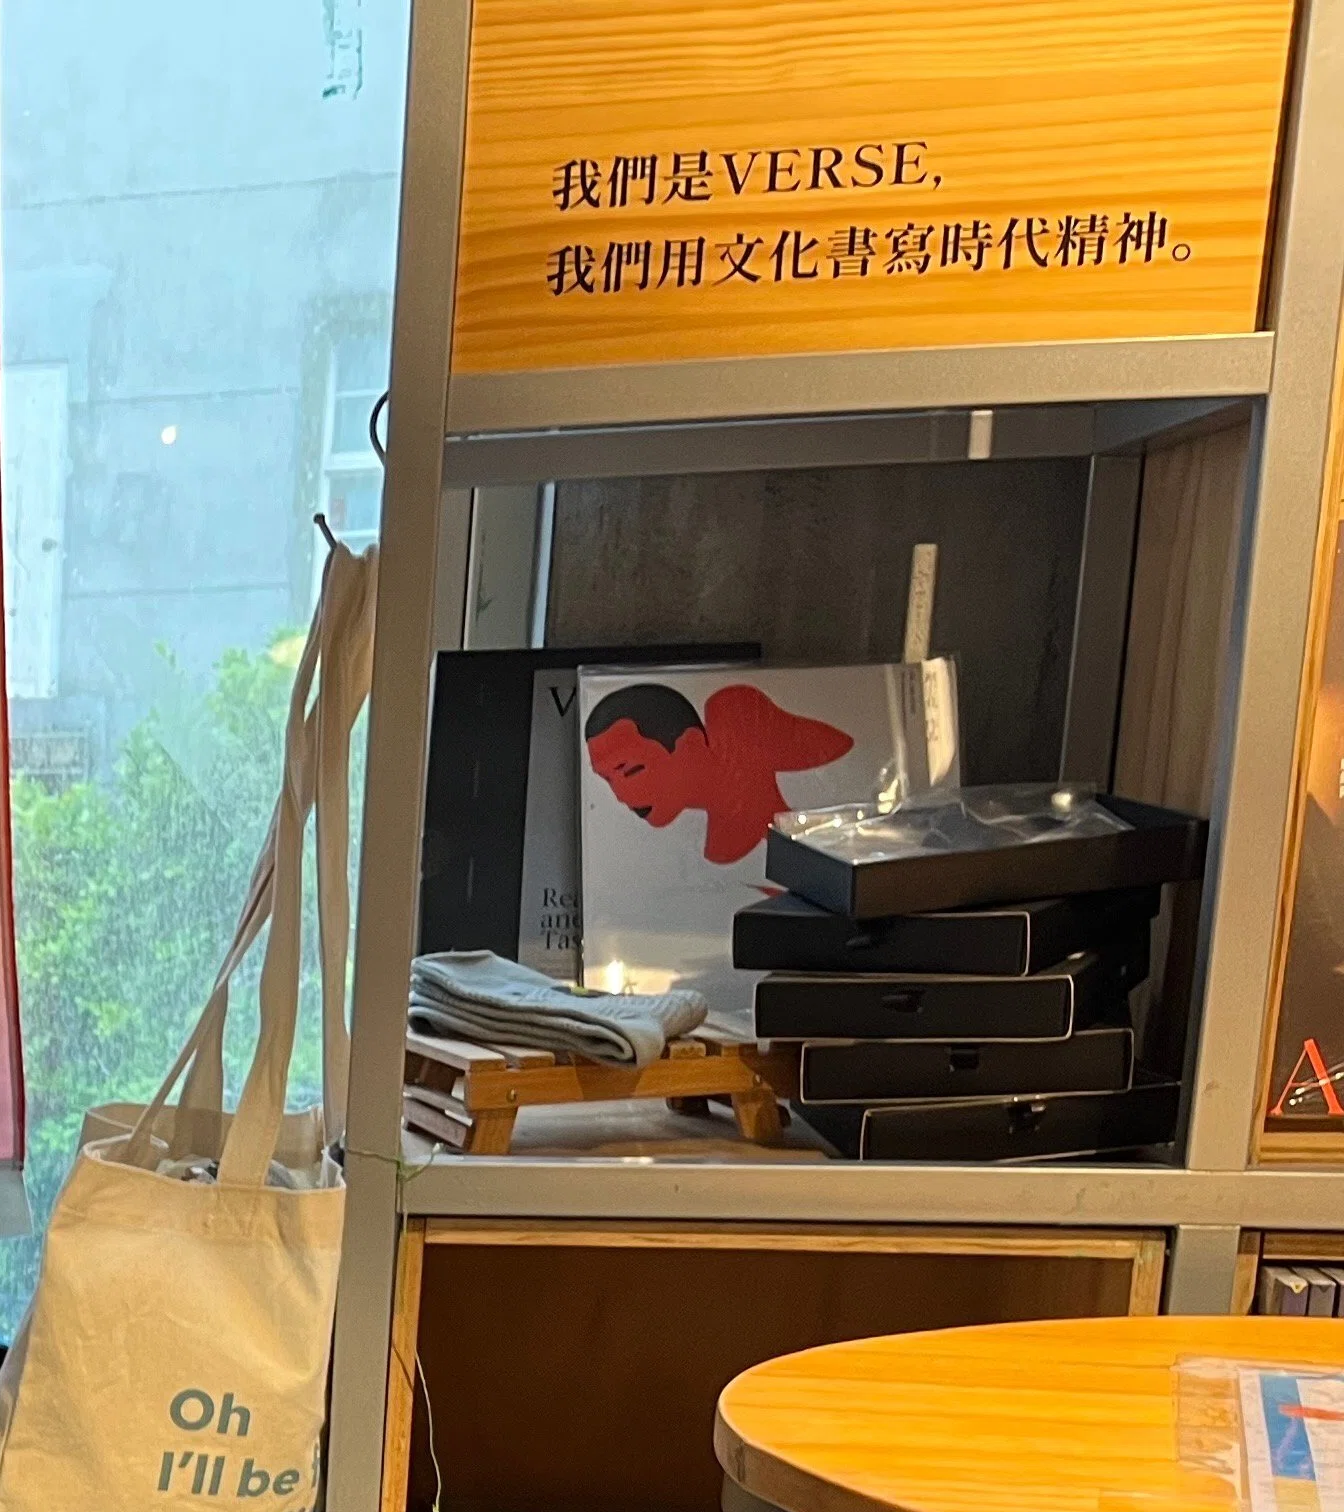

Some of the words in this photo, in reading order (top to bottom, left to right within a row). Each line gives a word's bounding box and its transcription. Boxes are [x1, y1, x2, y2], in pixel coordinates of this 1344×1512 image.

[551, 141, 944, 211] 我們是VERSE,
[546, 210, 1193, 296] 我們用文化書寫時代精神。
[169, 1388, 251, 1437] Oh
[158, 1451, 226, 1497] I'll
[236, 1458, 300, 1498] be
